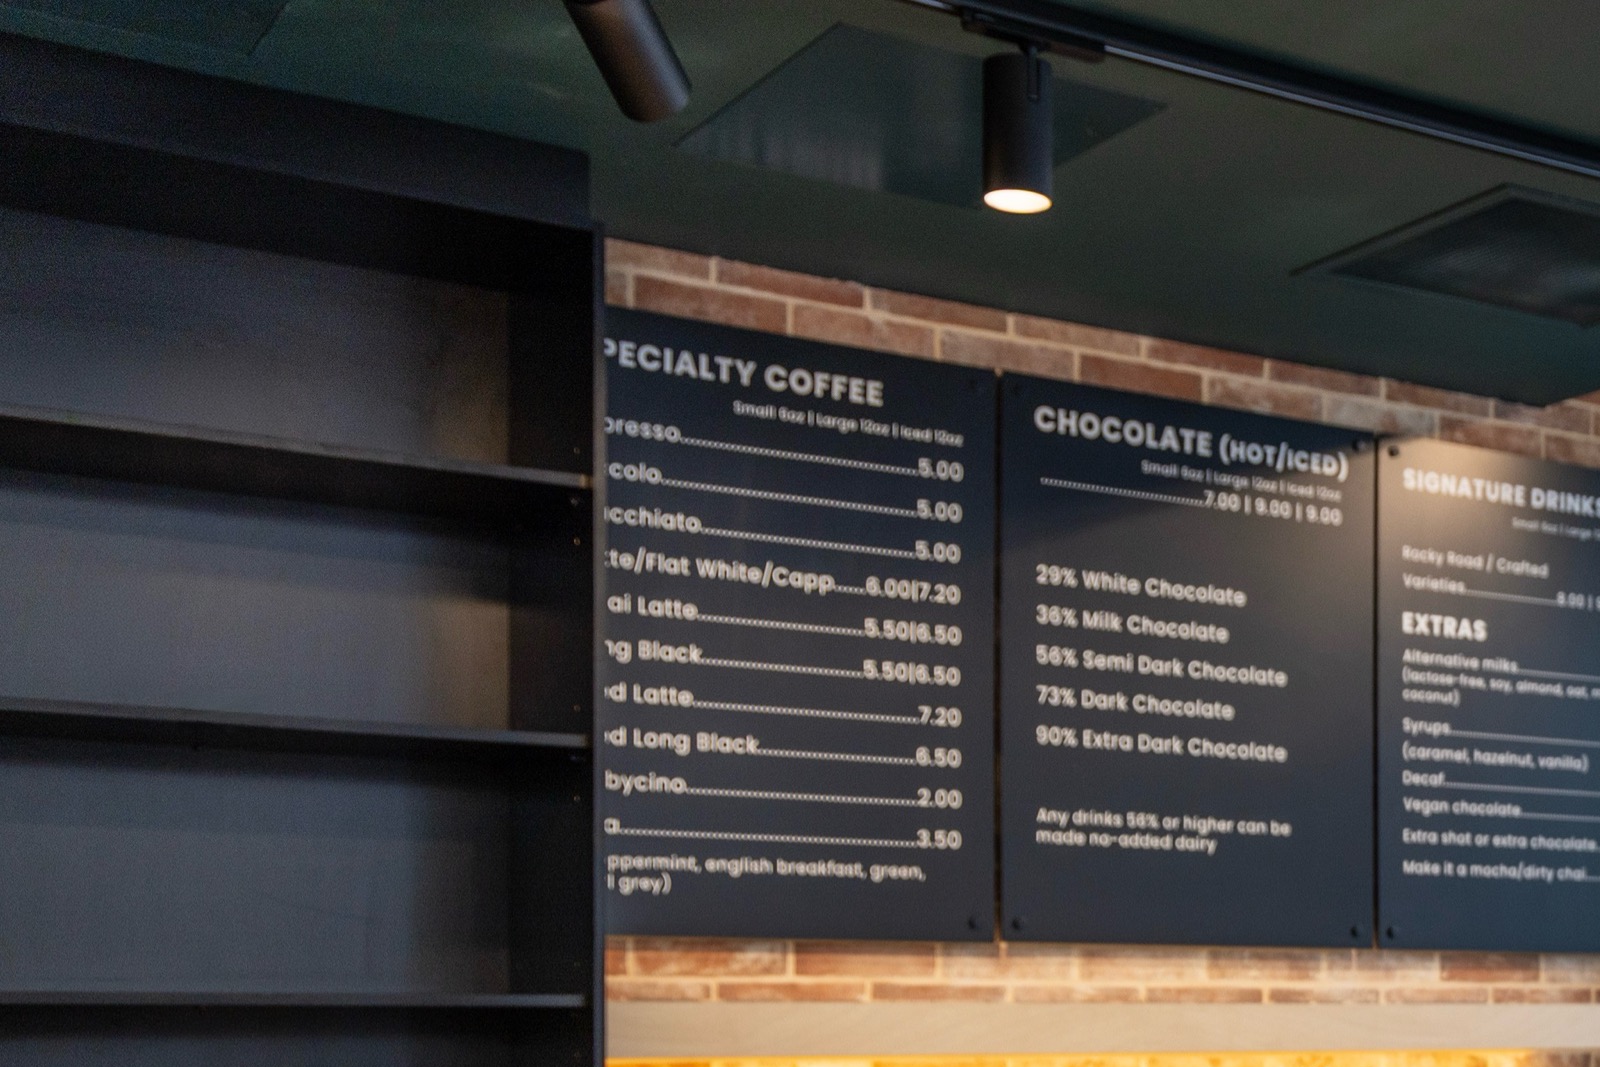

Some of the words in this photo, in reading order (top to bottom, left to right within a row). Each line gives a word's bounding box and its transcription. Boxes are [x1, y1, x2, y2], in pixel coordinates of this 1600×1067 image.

[764, 364, 884, 407] COFFEE
[732, 400, 777, 420] Small
[816, 412, 858, 434] Large
[860, 417, 890, 437] 12oz
[901, 425, 932, 443] Iced
[934, 428, 965, 448] 12oz
[1033, 405, 1213, 457] CHOCOLATE
[1219, 433, 1349, 482] (HOT/ICED)
[917, 457, 965, 482] 5.00
[1141, 459, 1178, 478] Small
[1213, 470, 1249, 491] Large
[1251, 476, 1278, 493] 12oz
[1287, 481, 1313, 497] Iced
[1316, 485, 1342, 502] 12oz
[1403, 467, 1526, 508] SIGNATURE
[916, 498, 963, 523] 5.00
[1203, 489, 1241, 512] 7.00
[1255, 497, 1293, 519] 9.00
[1305, 504, 1343, 526] 9.00
[914, 539, 962, 564] 5.00
[1402, 544, 1444, 567] Rocky
[1446, 549, 1483, 571] Road
[1496, 556, 1549, 579] Crafted
[696, 556, 836, 595] White/Capp
[1035, 562, 1078, 588] 29%
[1081, 568, 1141, 595] White
[1144, 576, 1247, 608] Chocolate
[1402, 573, 1466, 595] Varieties
[637, 595, 699, 621] Latte
[1082, 609, 1122, 633] Milk
[1126, 614, 1230, 644] Chocolate
[1401, 611, 1487, 642] EXTRAS
[637, 639, 704, 665] Black
[1035, 644, 1078, 668] 56%
[1082, 649, 1134, 672] Semi
[1138, 654, 1184, 678] Dark
[1187, 659, 1288, 688] Chocolate
[1402, 648, 1480, 671] Alternative
[1482, 656, 1518, 674] milks
[1035, 684, 1077, 707] 73%
[1081, 688, 1128, 712] Dark
[1132, 693, 1236, 721] Chocolate
[1402, 688, 1460, 708] coconut)
[1489, 677, 1513, 695] soy,
[1515, 679, 1564, 697] almond,
[1566, 685, 1588, 700] oat,
[604, 681, 628, 703] d
[633, 683, 695, 708] Latte
[917, 704, 963, 728] 7.20
[1402, 716, 1451, 739] Syrups
[604, 725, 628, 747] d
[633, 727, 692, 757] Long
[696, 731, 760, 756] Black
[915, 746, 962, 769] 6.50
[1035, 724, 1078, 748] 90%
[1082, 728, 1133, 751] Extra
[1138, 732, 1184, 755] Dark
[1187, 736, 1288, 763] Chocolate
[1402, 740, 1471, 764] (caramel,
[1473, 748, 1535, 769] hazelnut,
[1538, 753, 1588, 774] vanilla)
[604, 768, 688, 797] bycino
[917, 787, 963, 810] 2.00
[1402, 769, 1445, 788] Decaf
[1035, 806, 1070, 829] Any
[1072, 807, 1124, 829] drinks
[1162, 816, 1180, 830] or
[1183, 814, 1234, 837] higher
[1237, 820, 1267, 835] can
[1269, 818, 1292, 837] be
[1403, 796, 1450, 818] Vegan
[1451, 799, 1521, 818] chocolate
[917, 828, 962, 850] 3.50
[1035, 829, 1087, 846] made
[1089, 829, 1172, 851] no-added
[1175, 834, 1218, 857] dairy
[1402, 827, 1438, 846] Extra
[1441, 830, 1472, 847] shot
[1474, 834, 1490, 848] or
[1492, 834, 1528, 850] extra
[1530, 834, 1597, 852] chocolate
[618, 871, 672, 896] grey)
[705, 855, 774, 879] english
[776, 857, 868, 881] breakfast,
[869, 862, 927, 883] green,
[1402, 859, 1440, 876] Make
[1443, 860, 1455, 877] it
[1456, 864, 1468, 878] a
[1470, 861, 1554, 885] mocha/dirty
[1556, 866, 1586, 882] chai
